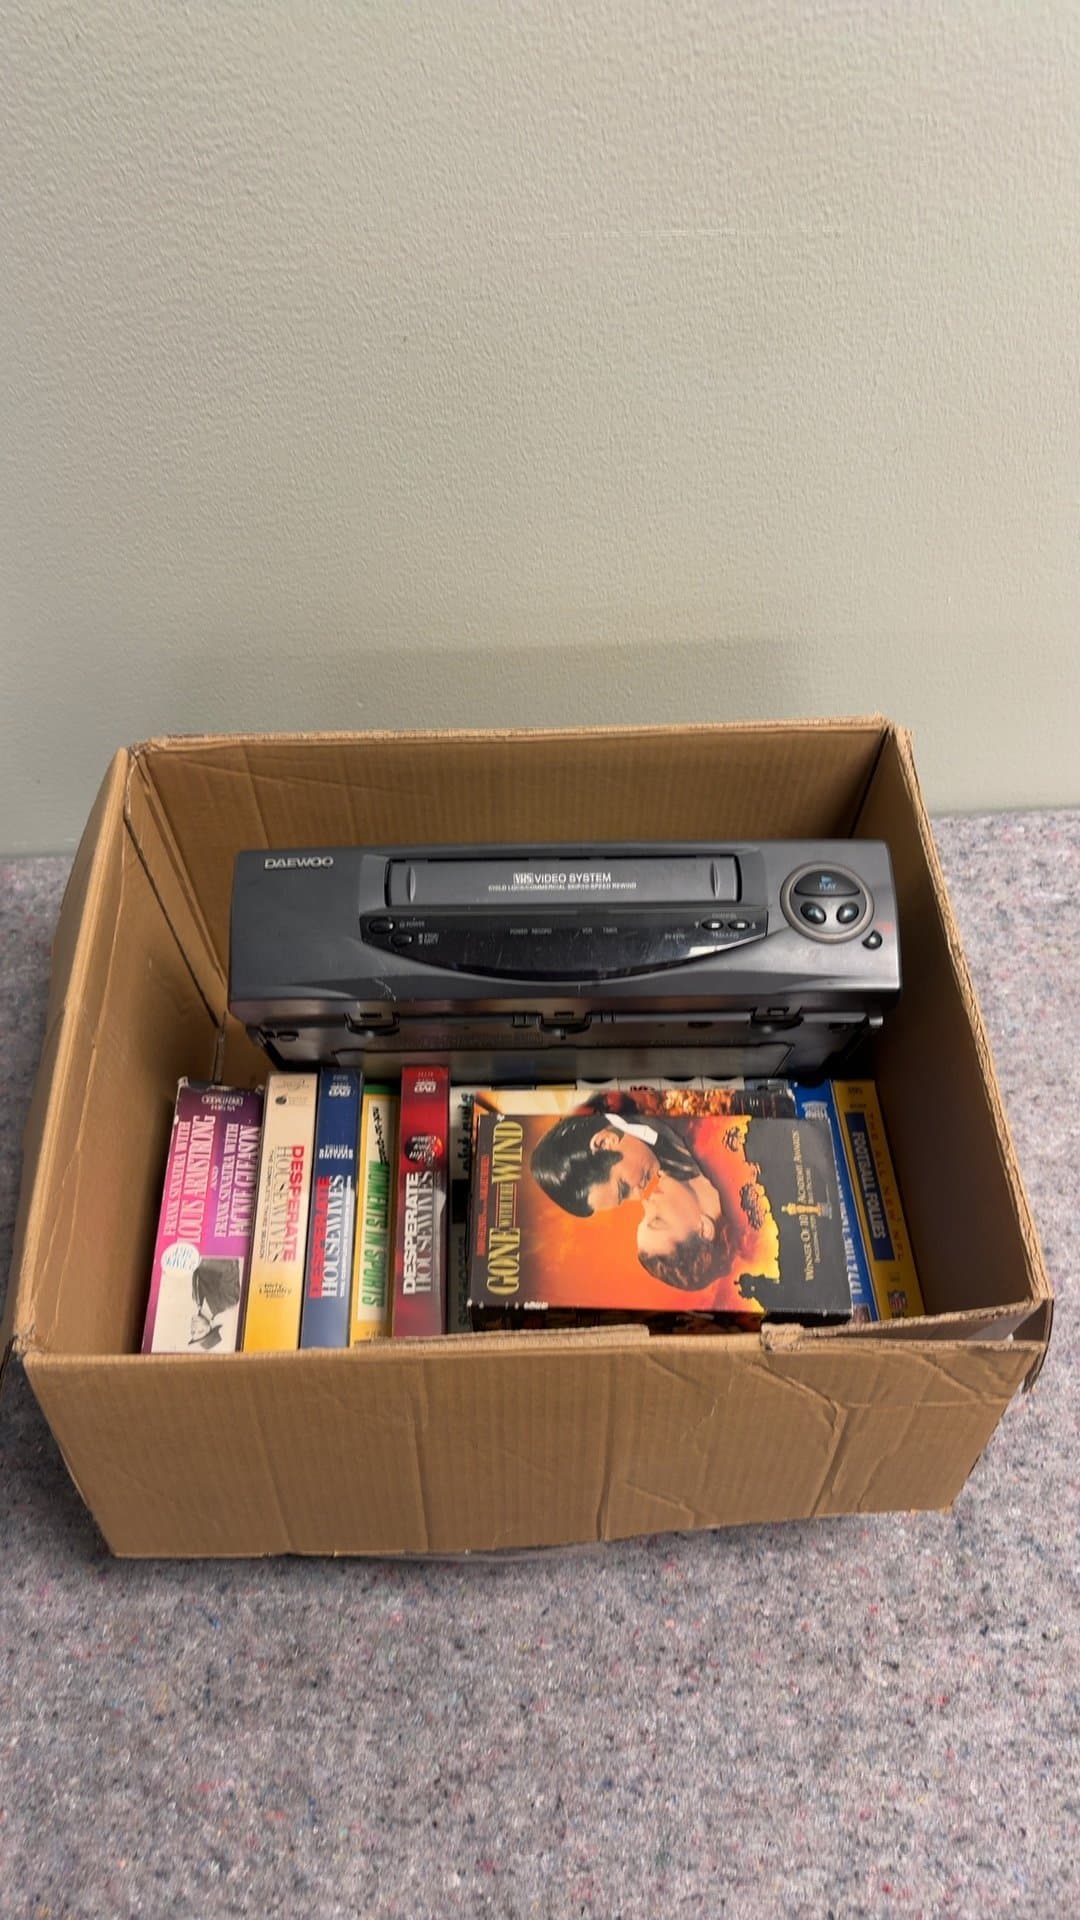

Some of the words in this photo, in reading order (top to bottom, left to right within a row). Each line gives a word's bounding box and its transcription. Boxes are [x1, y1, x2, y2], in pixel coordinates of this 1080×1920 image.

[264, 857, 334, 869] DAEWOO
[513, 872, 534, 885] VHS
[535, 872, 567, 884] VIDEO
[569, 872, 611, 883] SYSTEM
[175, 1120, 192, 1153] WITH
[183, 1115, 216, 1199] ARMSTRONG
[224, 1122, 239, 1156] WITH
[234, 1124, 260, 1188] GLEASON
[491, 1121, 524, 1185] WIND
[169, 1153, 187, 1199] SINATRA
[219, 1155, 236, 1201] SINATRA
[266, 1145, 294, 1263] HOUSEWIVES
[282, 1145, 305, 1263] DESPERATE
[365, 1160, 391, 1229] MOMENTS
[852, 1131, 875, 1190] FOOTBALL
[865, 1191, 886, 1239] FOLLIES
[163, 1196, 181, 1237] FRANK
[176, 1199, 205, 1244] LOUIS
[214, 1198, 232, 1238] FRANK
[228, 1186, 254, 1237] JACKIE
[309, 1175, 331, 1298] DESPERATE
[321, 1174, 345, 1298] HOUSEWIVES
[364, 1231, 388, 1246] IN
[403, 1171, 419, 1295] DESPERATE
[415, 1169, 433, 1292] HOUSEWIVES
[361, 1250, 388, 1308] SPORTS
[486, 1227, 521, 1296] GONE
